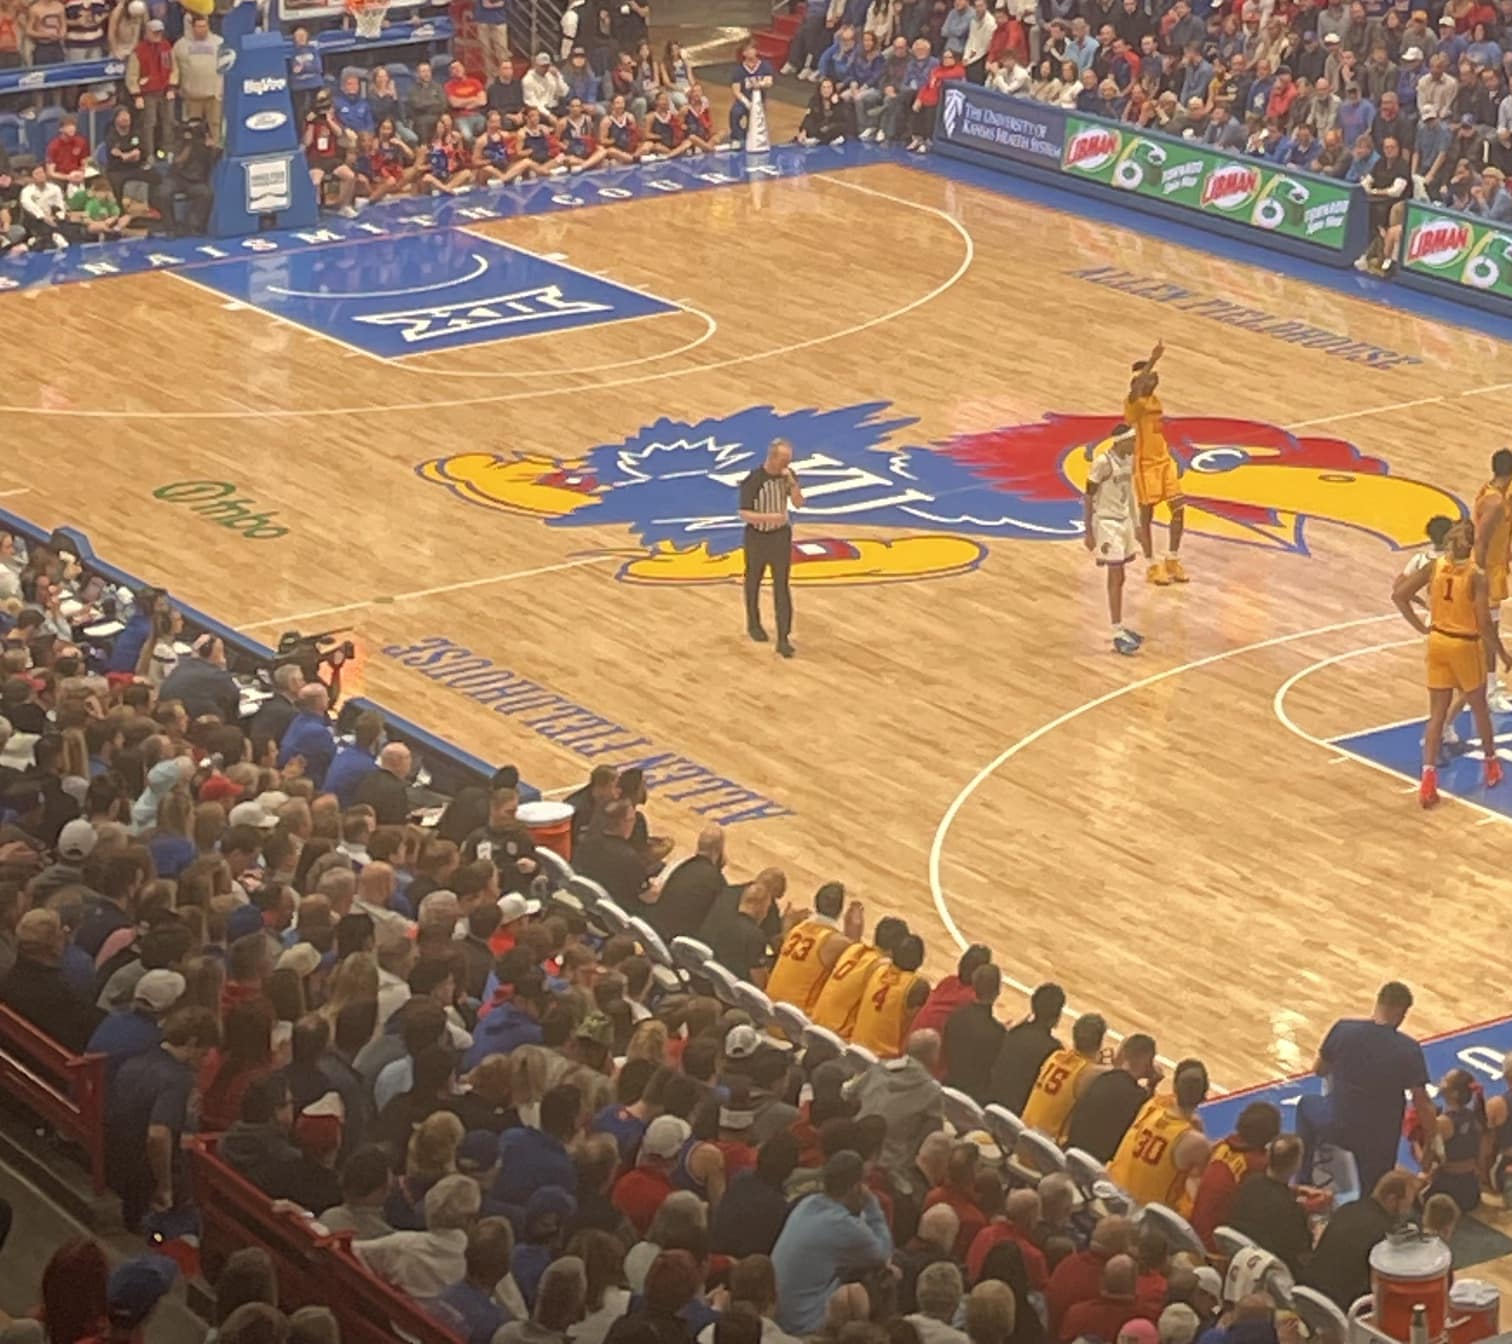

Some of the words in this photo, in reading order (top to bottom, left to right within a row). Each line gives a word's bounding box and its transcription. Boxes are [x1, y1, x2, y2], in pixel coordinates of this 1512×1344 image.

[1068, 128, 1118, 164] LIBMAN
[1203, 168, 1259, 205] LIBMAN
[1408, 225, 1469, 261] LIBMAN
[1443, 578, 1453, 602] 1
[1036, 1066, 1064, 1096] 15
[1132, 1133, 1167, 1166] 30
